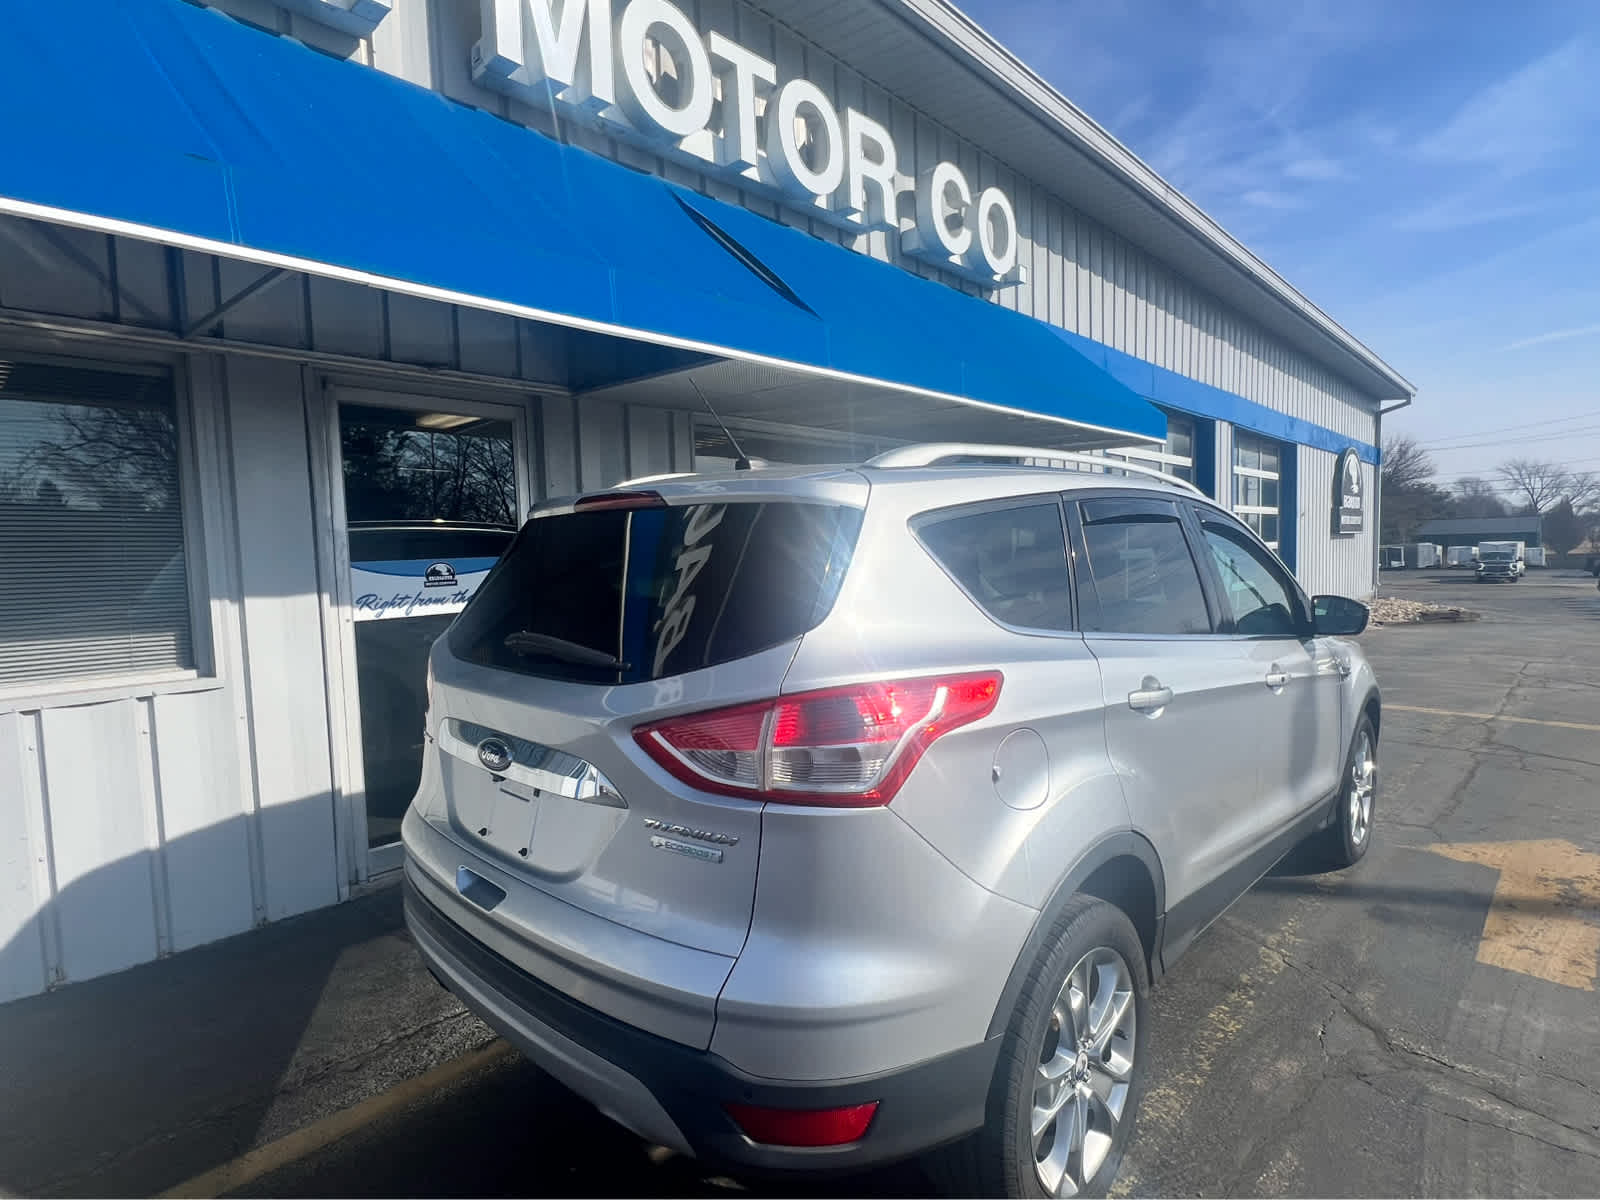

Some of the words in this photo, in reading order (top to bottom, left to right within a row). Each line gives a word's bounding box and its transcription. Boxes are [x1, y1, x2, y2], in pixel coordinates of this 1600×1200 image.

[494, 0, 899, 228] MOTOR
[355, 594, 409, 618] Right
[406, 591, 450, 615] from
